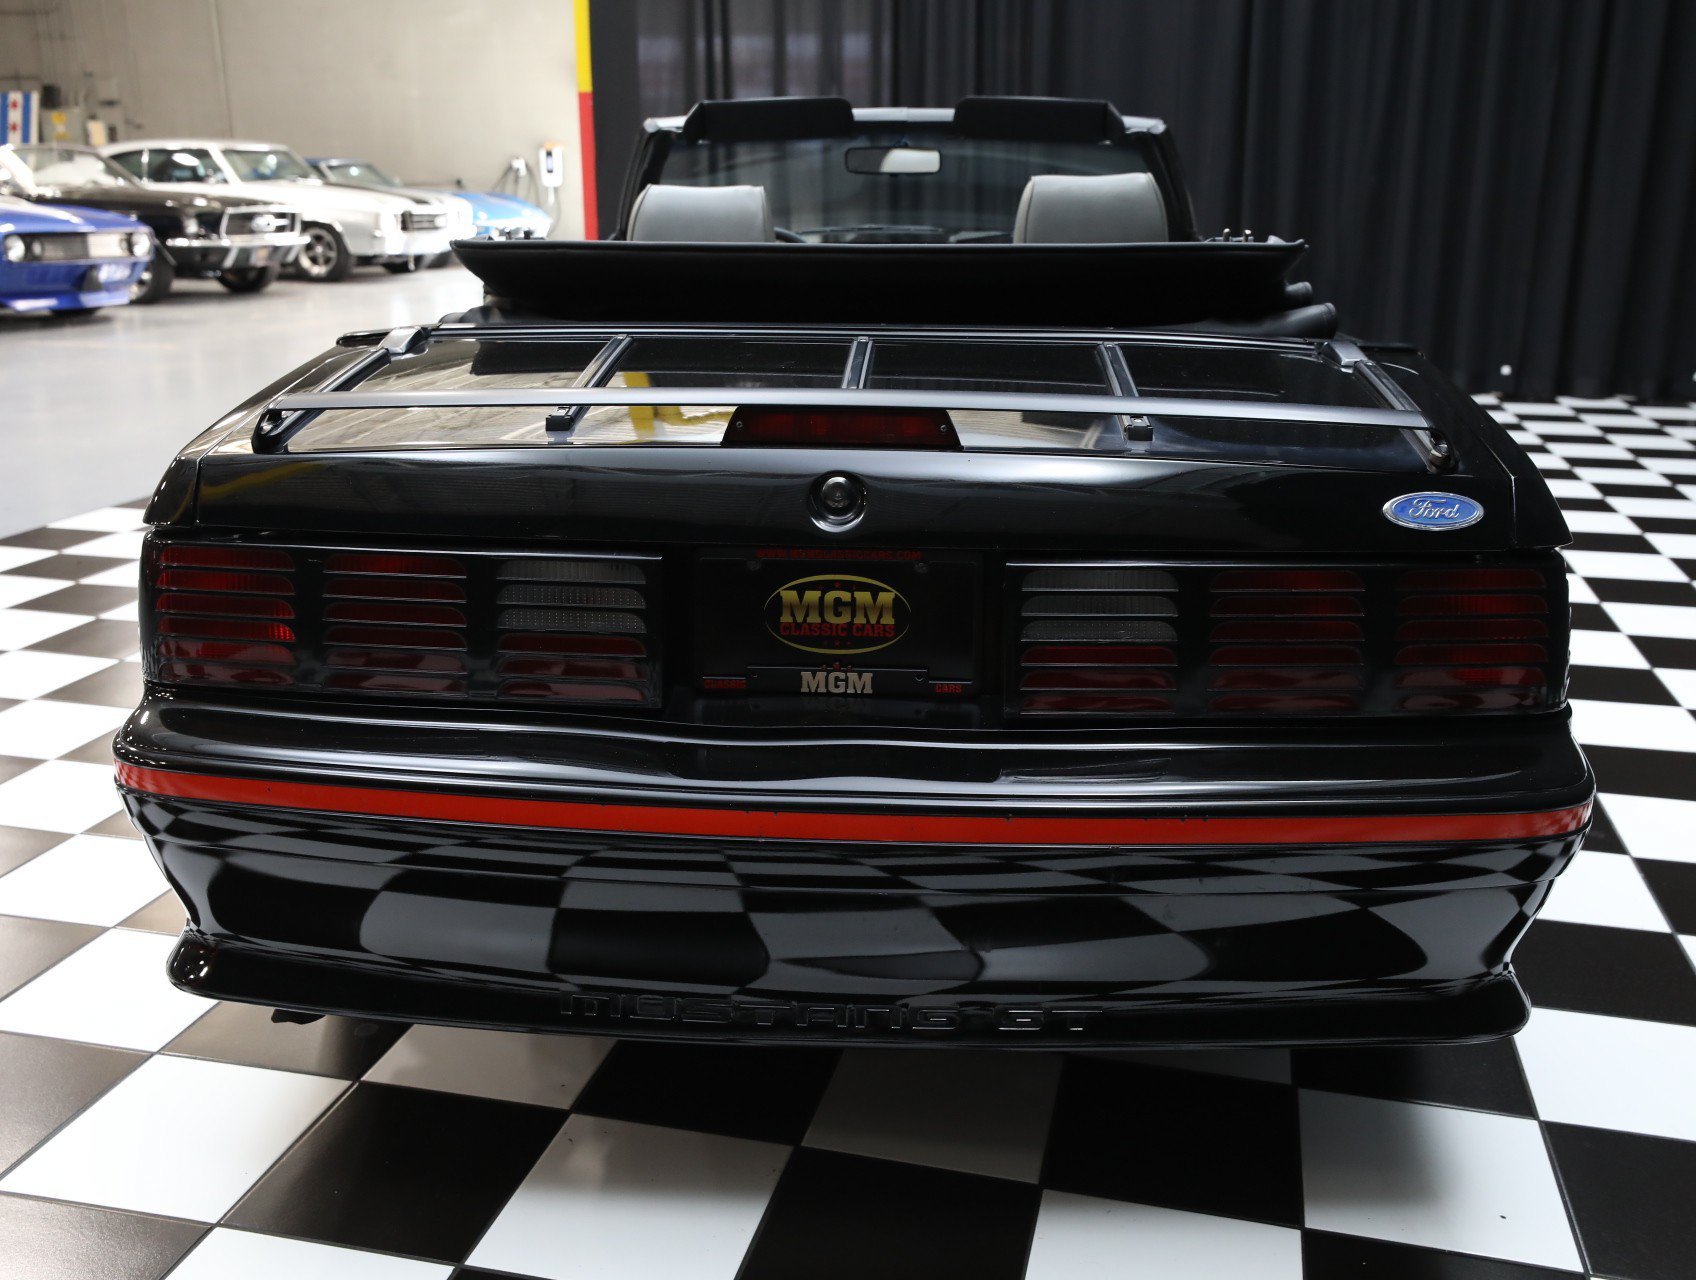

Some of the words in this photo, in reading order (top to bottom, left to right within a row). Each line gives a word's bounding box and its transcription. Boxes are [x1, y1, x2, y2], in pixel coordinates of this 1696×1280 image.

[1408, 497, 1460, 519] Ford
[779, 589, 896, 625] MGM
[779, 623, 848, 636] CLASSIC
[852, 624, 896, 637] CARS
[704, 679, 747, 689] CLASSIC
[800, 671, 873, 694] MGM
[935, 683, 963, 693] CARS
[559, 991, 958, 1030] MUSTANG
[992, 1005, 1103, 1032] GT
